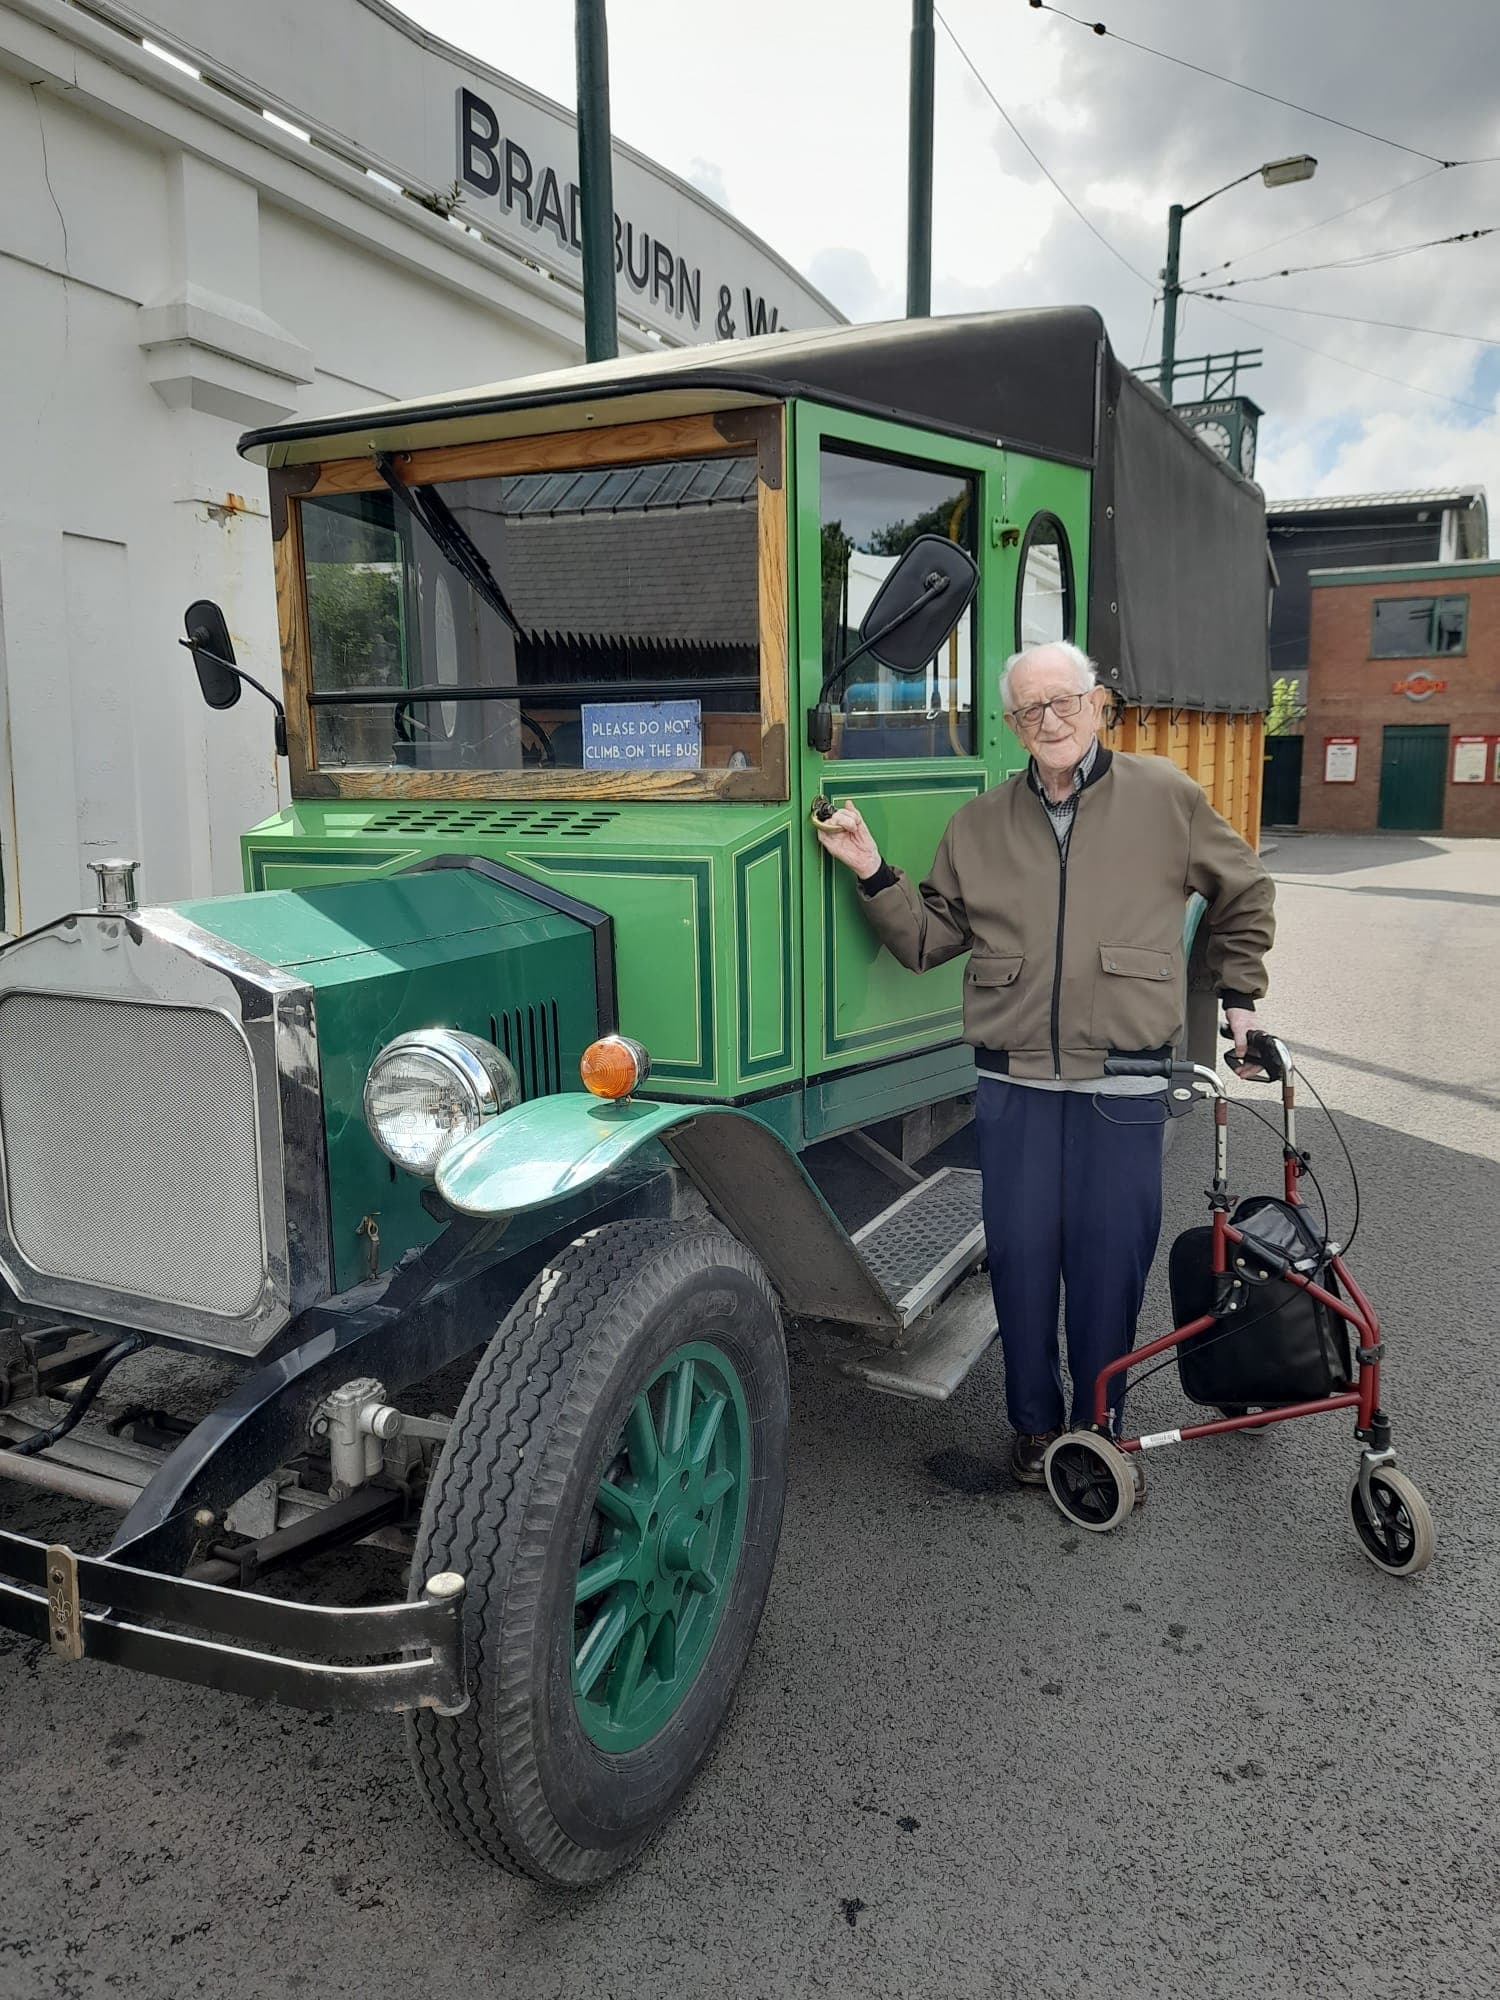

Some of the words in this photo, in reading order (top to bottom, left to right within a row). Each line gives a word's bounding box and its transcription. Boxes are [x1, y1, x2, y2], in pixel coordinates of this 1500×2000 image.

[715, 284, 736, 340] &
[743, 287, 789, 336] W
[592, 721, 635, 736] PLEASE
[639, 720, 659, 734] DO
[664, 719, 691, 734] NOT
[585, 745, 620, 759] CLIMB
[625, 744, 644, 758] ON
[649, 743, 671, 757] THE
[676, 742, 699, 757] BUS
